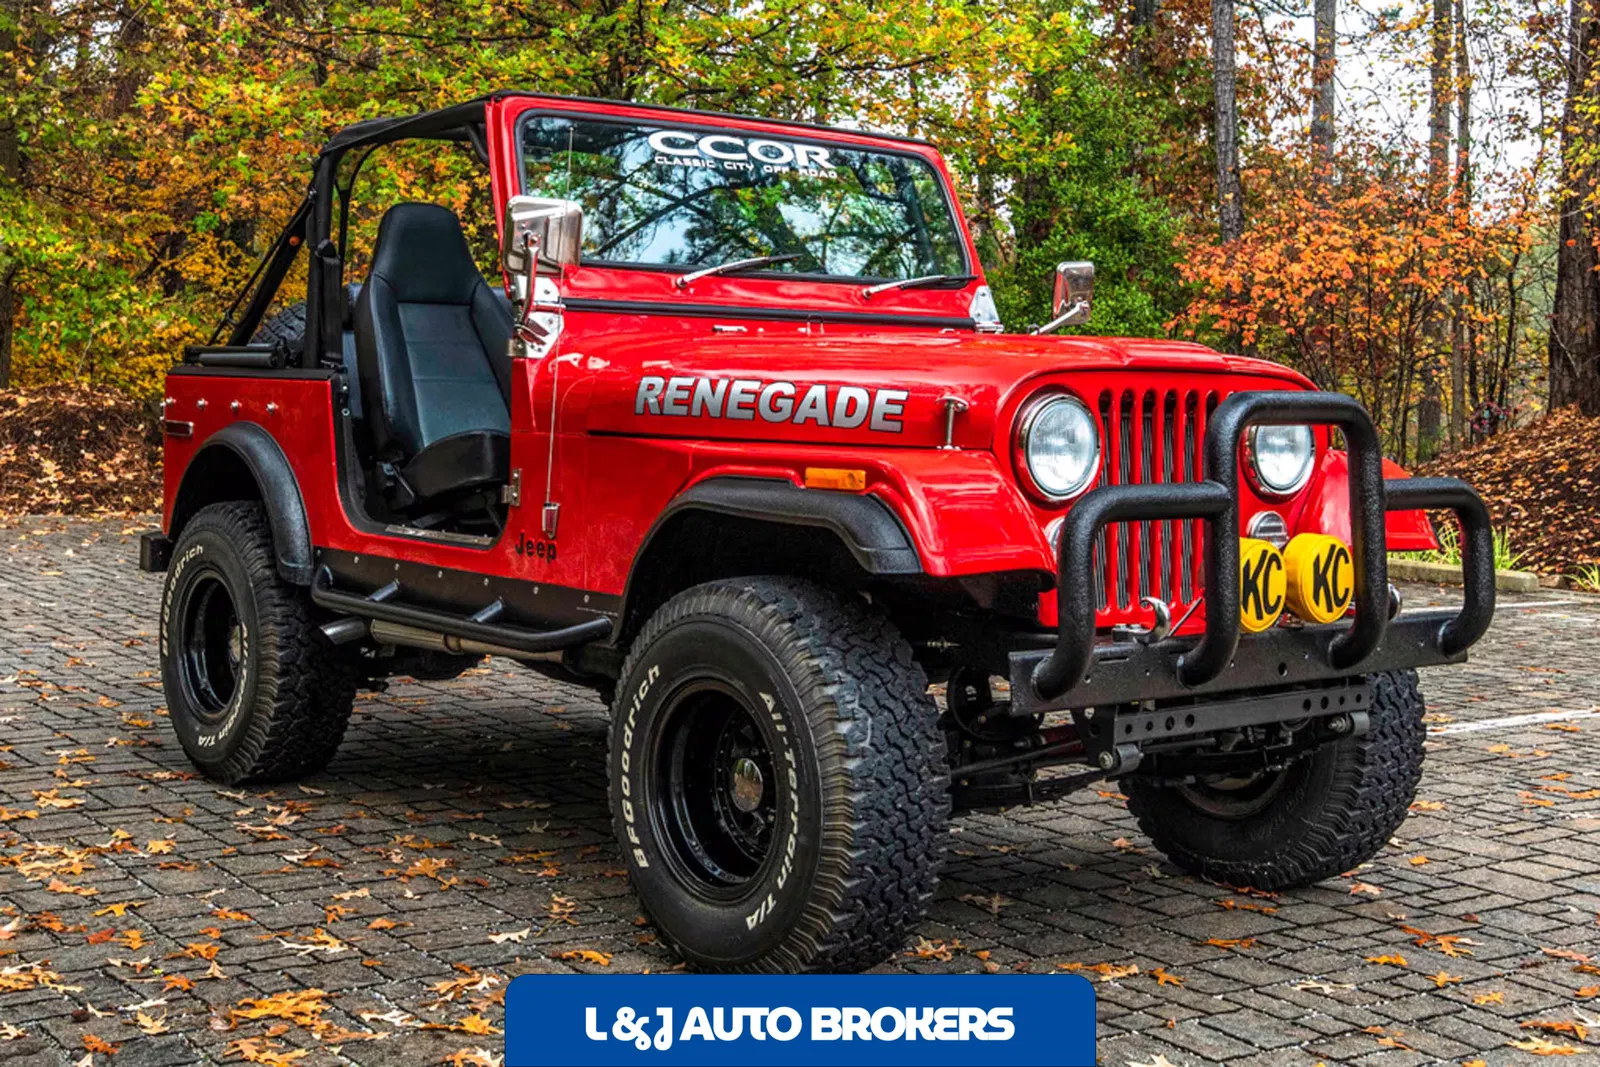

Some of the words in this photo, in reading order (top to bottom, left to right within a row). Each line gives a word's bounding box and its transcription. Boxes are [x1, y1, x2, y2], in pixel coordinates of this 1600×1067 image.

[648, 130, 836, 169] CCOR
[654, 156, 715, 169] CLASSIC
[723, 161, 754, 171] CITY
[763, 165, 789, 174] OFF
[634, 376, 909, 433] RENEGADE
[515, 532, 557, 564] Jeep
[1242, 549, 1282, 620] KC
[1313, 544, 1349, 613] KC
[621, 664, 661, 868] BFGoodrich
[746, 893, 776, 931] T/A
